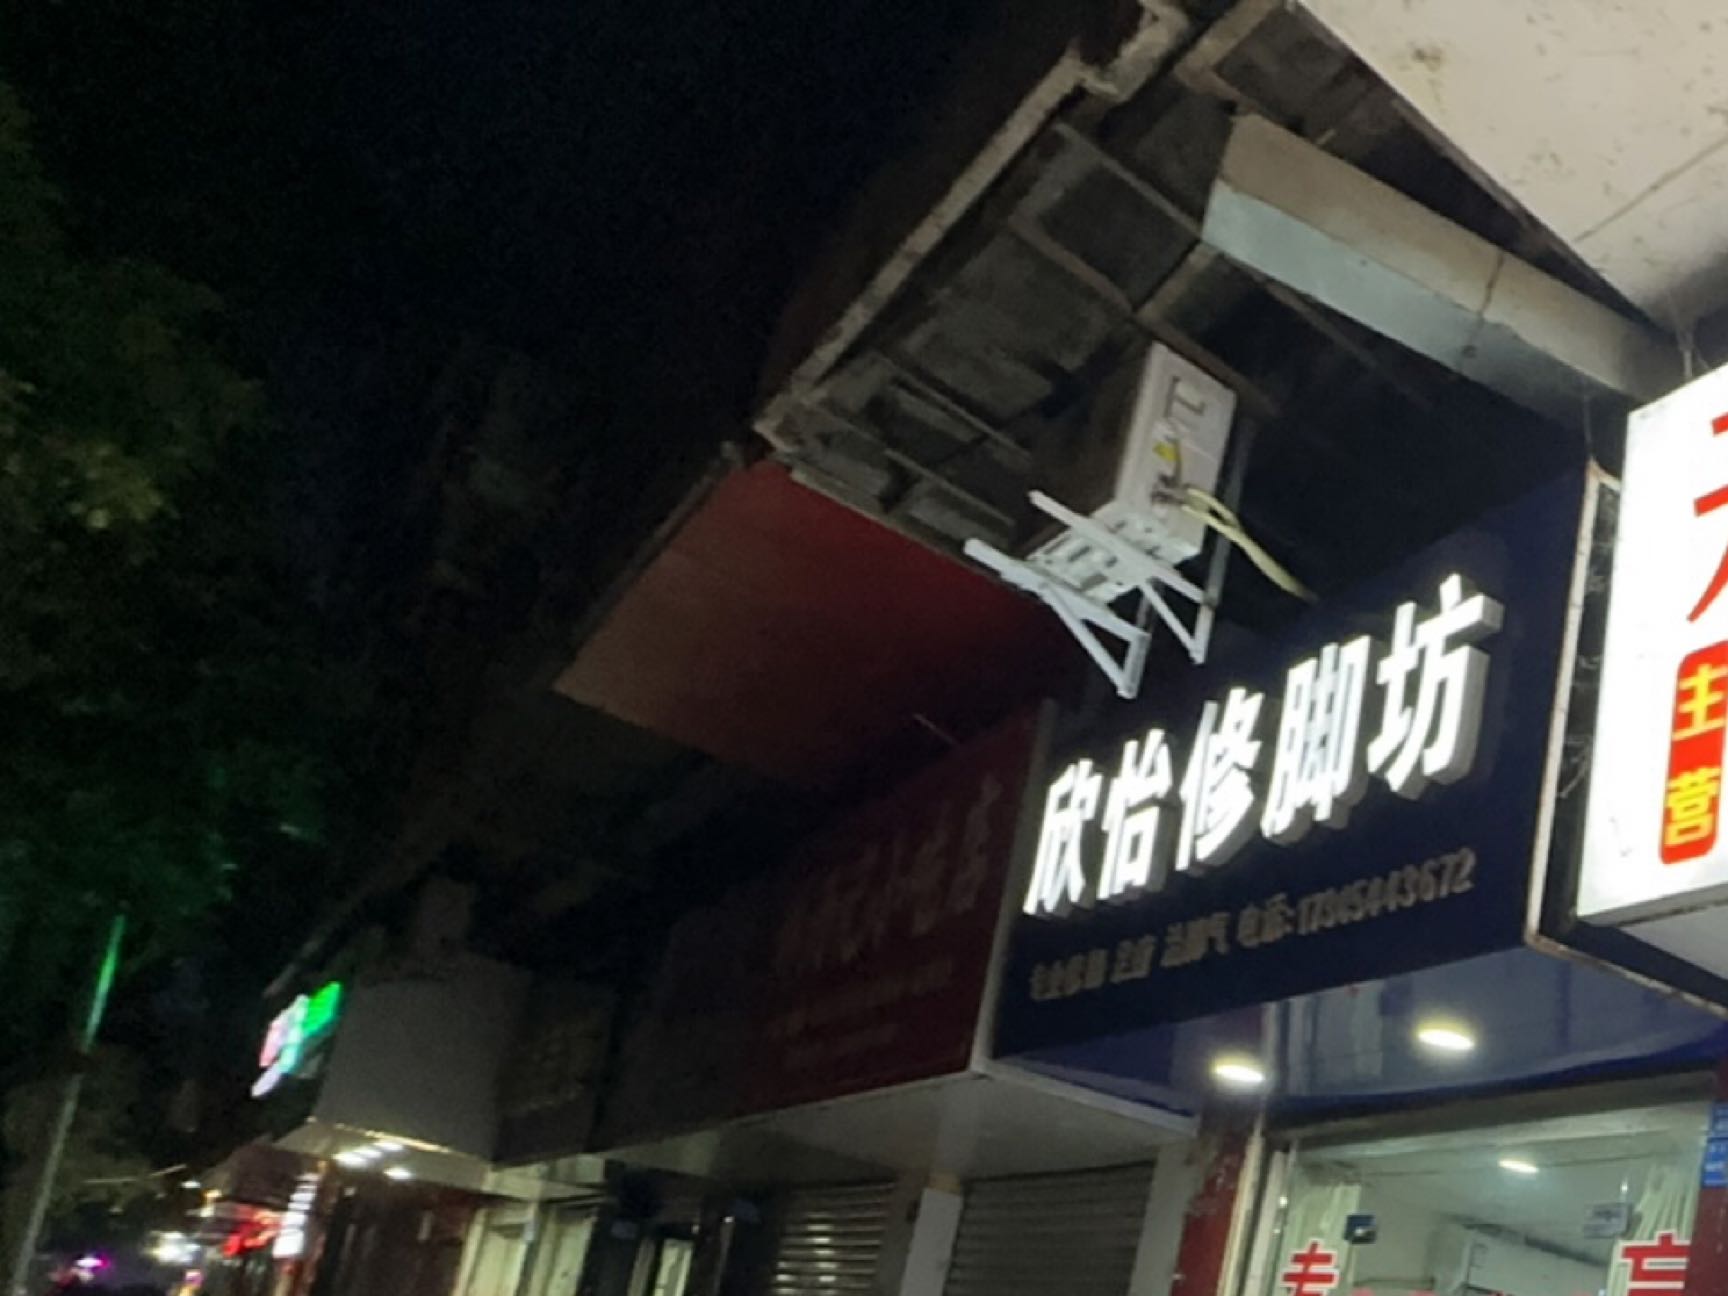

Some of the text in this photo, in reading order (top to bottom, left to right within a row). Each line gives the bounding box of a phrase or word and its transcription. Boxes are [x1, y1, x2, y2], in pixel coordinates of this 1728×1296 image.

[1022, 573, 1506, 915] 欣怡修脚坊
